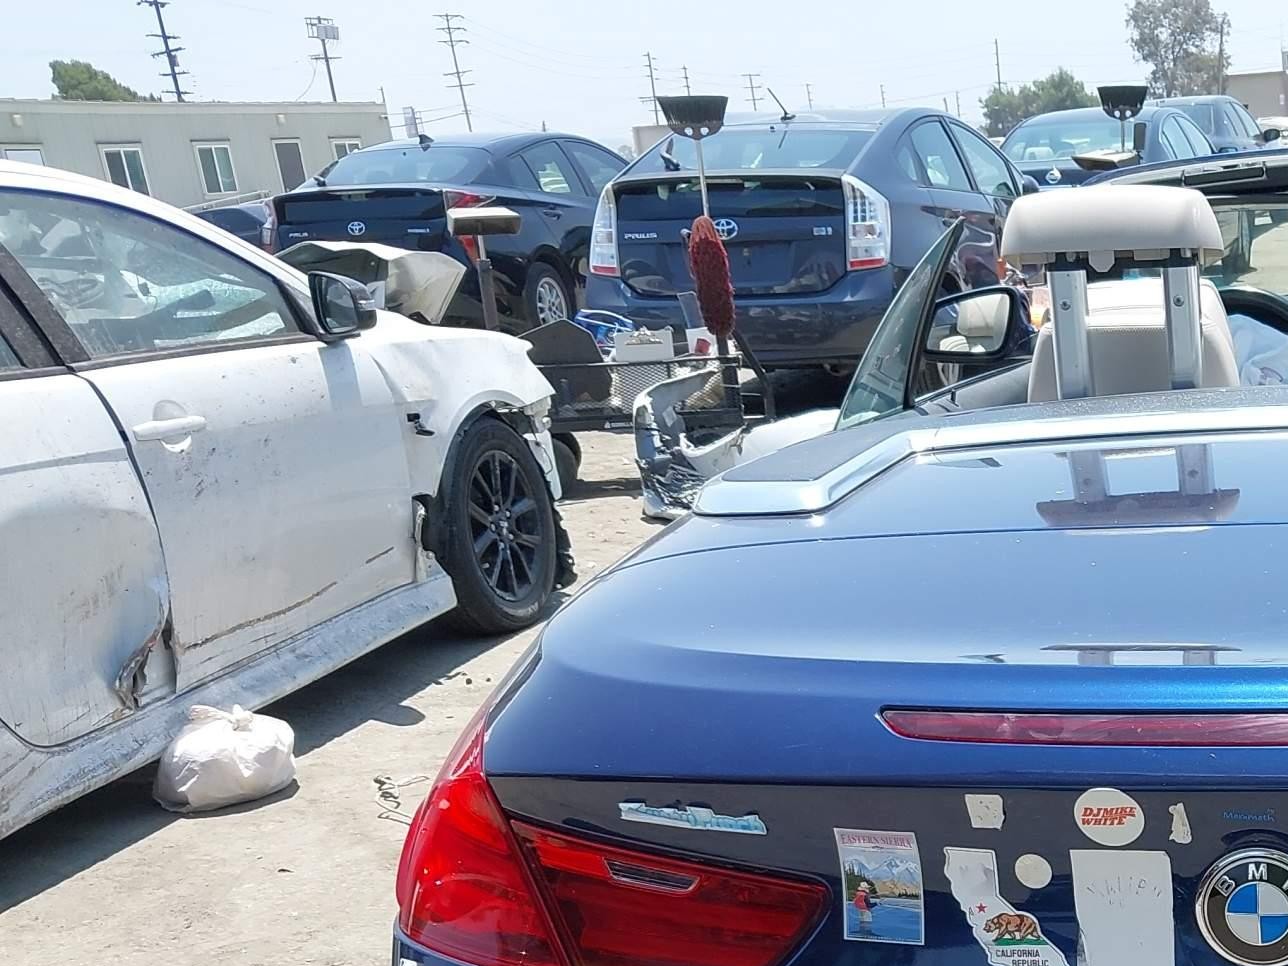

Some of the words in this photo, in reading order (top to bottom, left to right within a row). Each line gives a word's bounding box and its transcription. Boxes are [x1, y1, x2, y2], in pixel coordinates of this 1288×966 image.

[1081, 815, 1127, 826] WHITE
[840, 835, 880, 846] EASTERN
[880, 837, 913, 849] SIERRA
[995, 949, 1040, 958] CALIFORNIA
